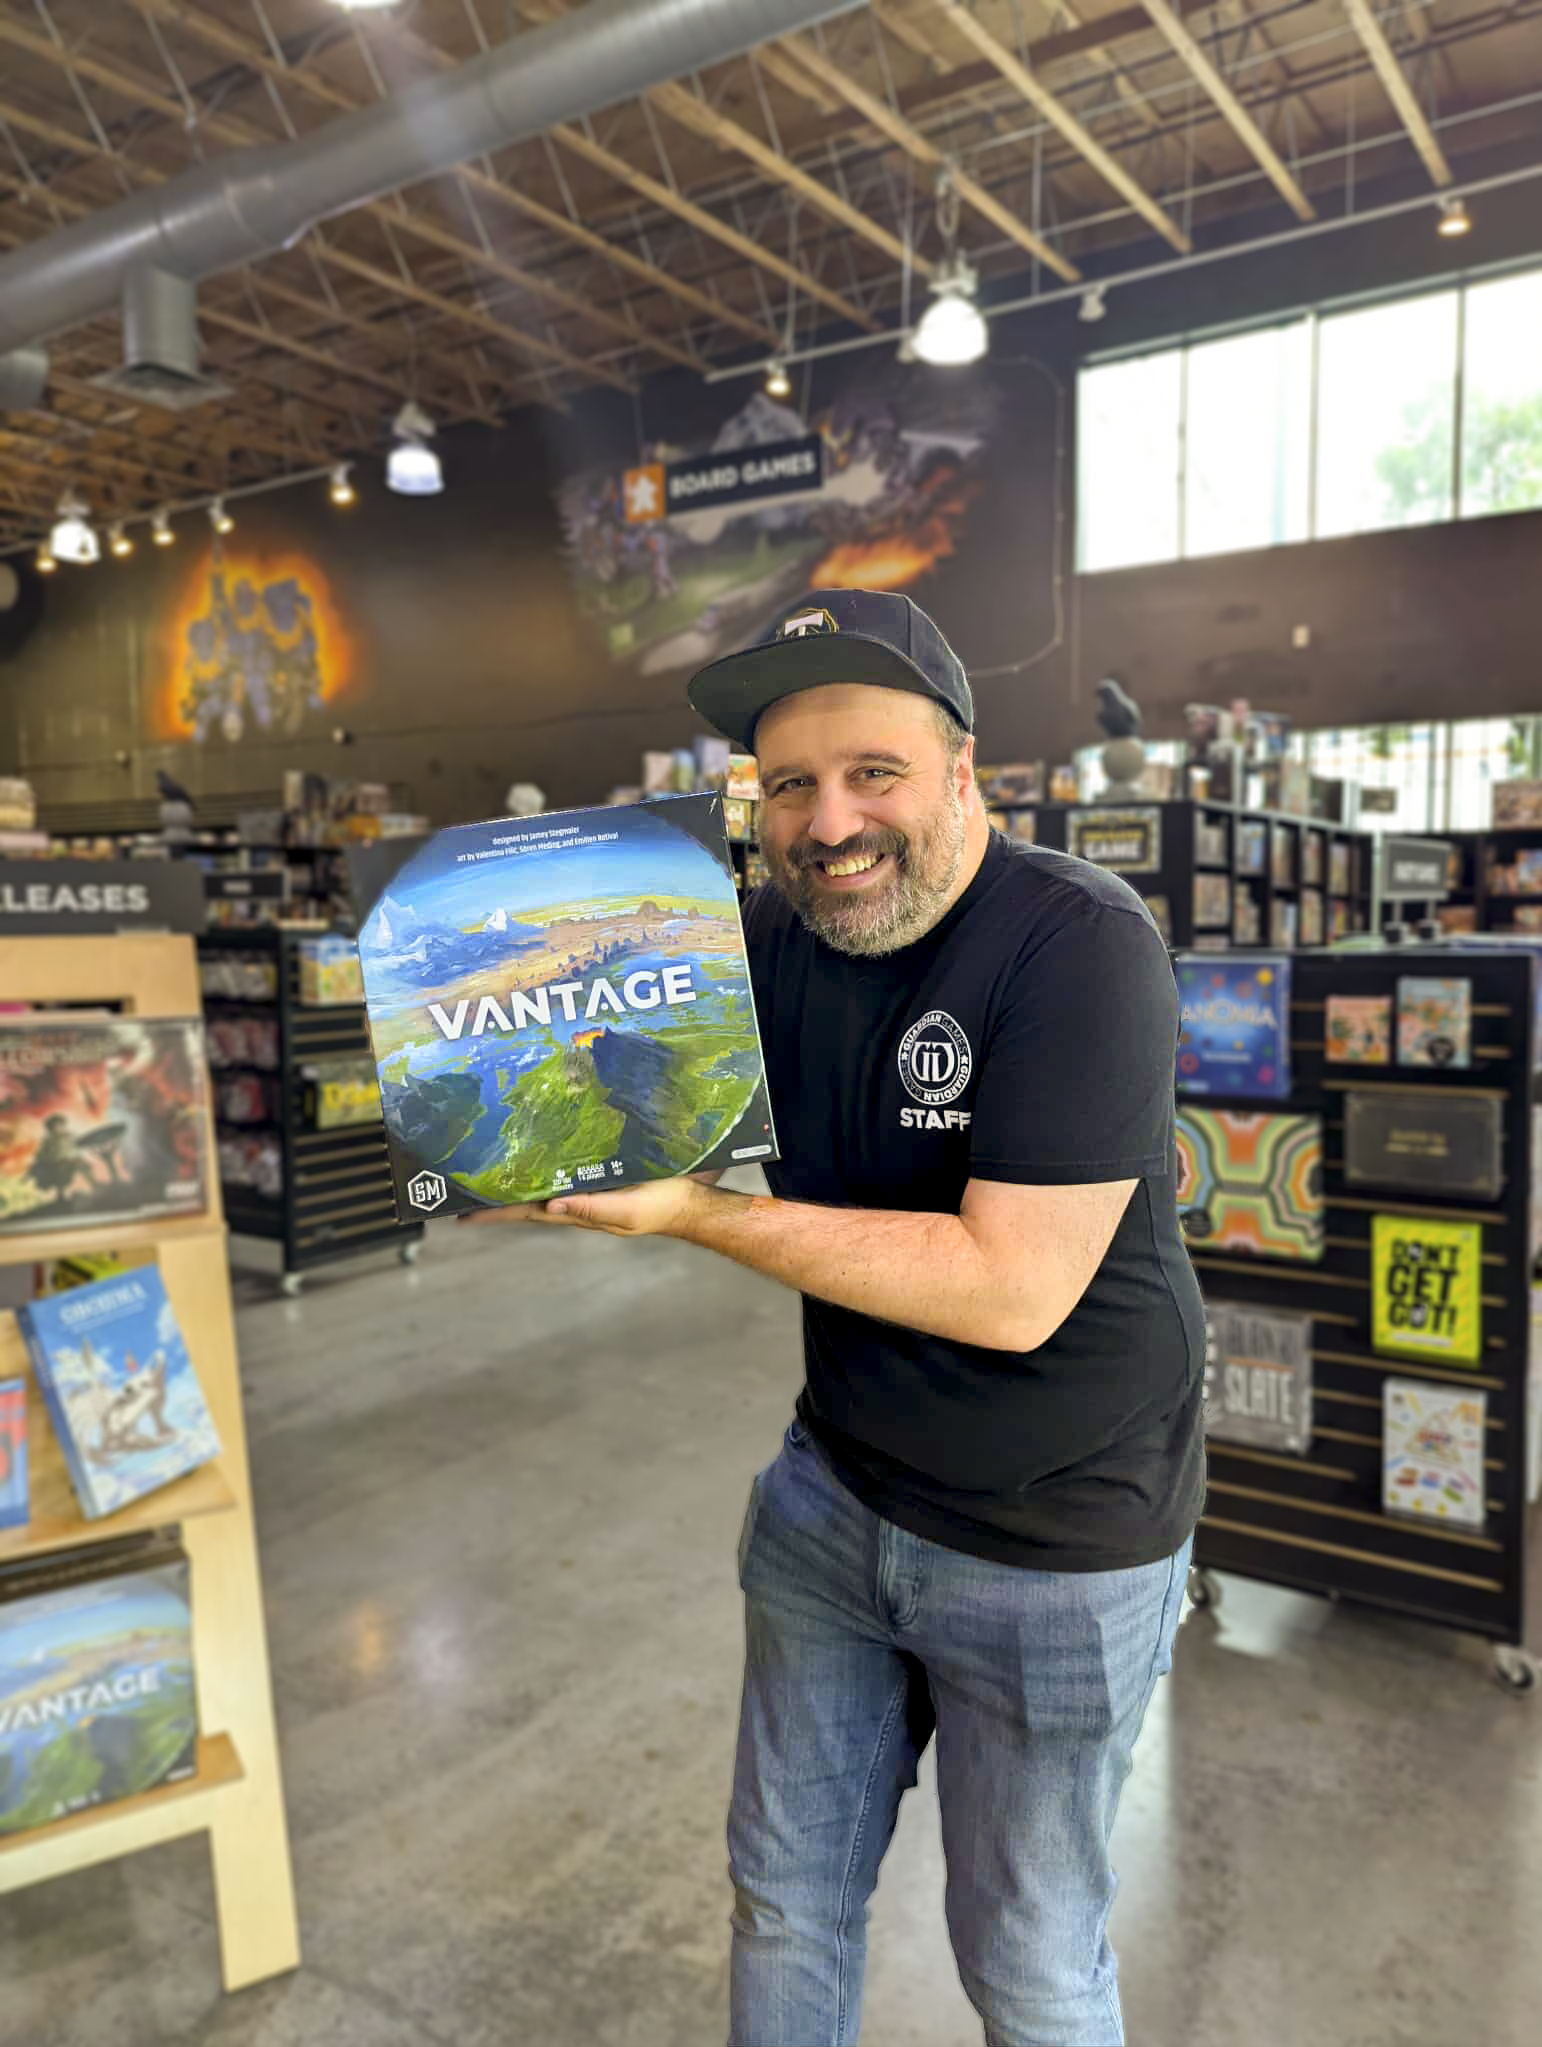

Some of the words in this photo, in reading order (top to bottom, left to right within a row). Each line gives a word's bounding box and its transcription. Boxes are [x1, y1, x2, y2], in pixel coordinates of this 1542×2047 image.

[669, 465, 739, 499] BOARD
[741, 451, 817, 485] GAMES
[0, 883, 150, 914] LEASES
[428, 964, 697, 1041] VANTAGE
[903, 1013, 942, 1051] GUARDIAN
[923, 1065, 969, 1102] GUARDIAN
[900, 1108, 972, 1132] STAFF
[414, 1178, 441, 1202] SM
[1391, 1239, 1461, 1265] DON'T
[1387, 1264, 1459, 1302] GET
[1388, 1301, 1457, 1337] GOT!
[1224, 1362, 1295, 1425] SLATE
